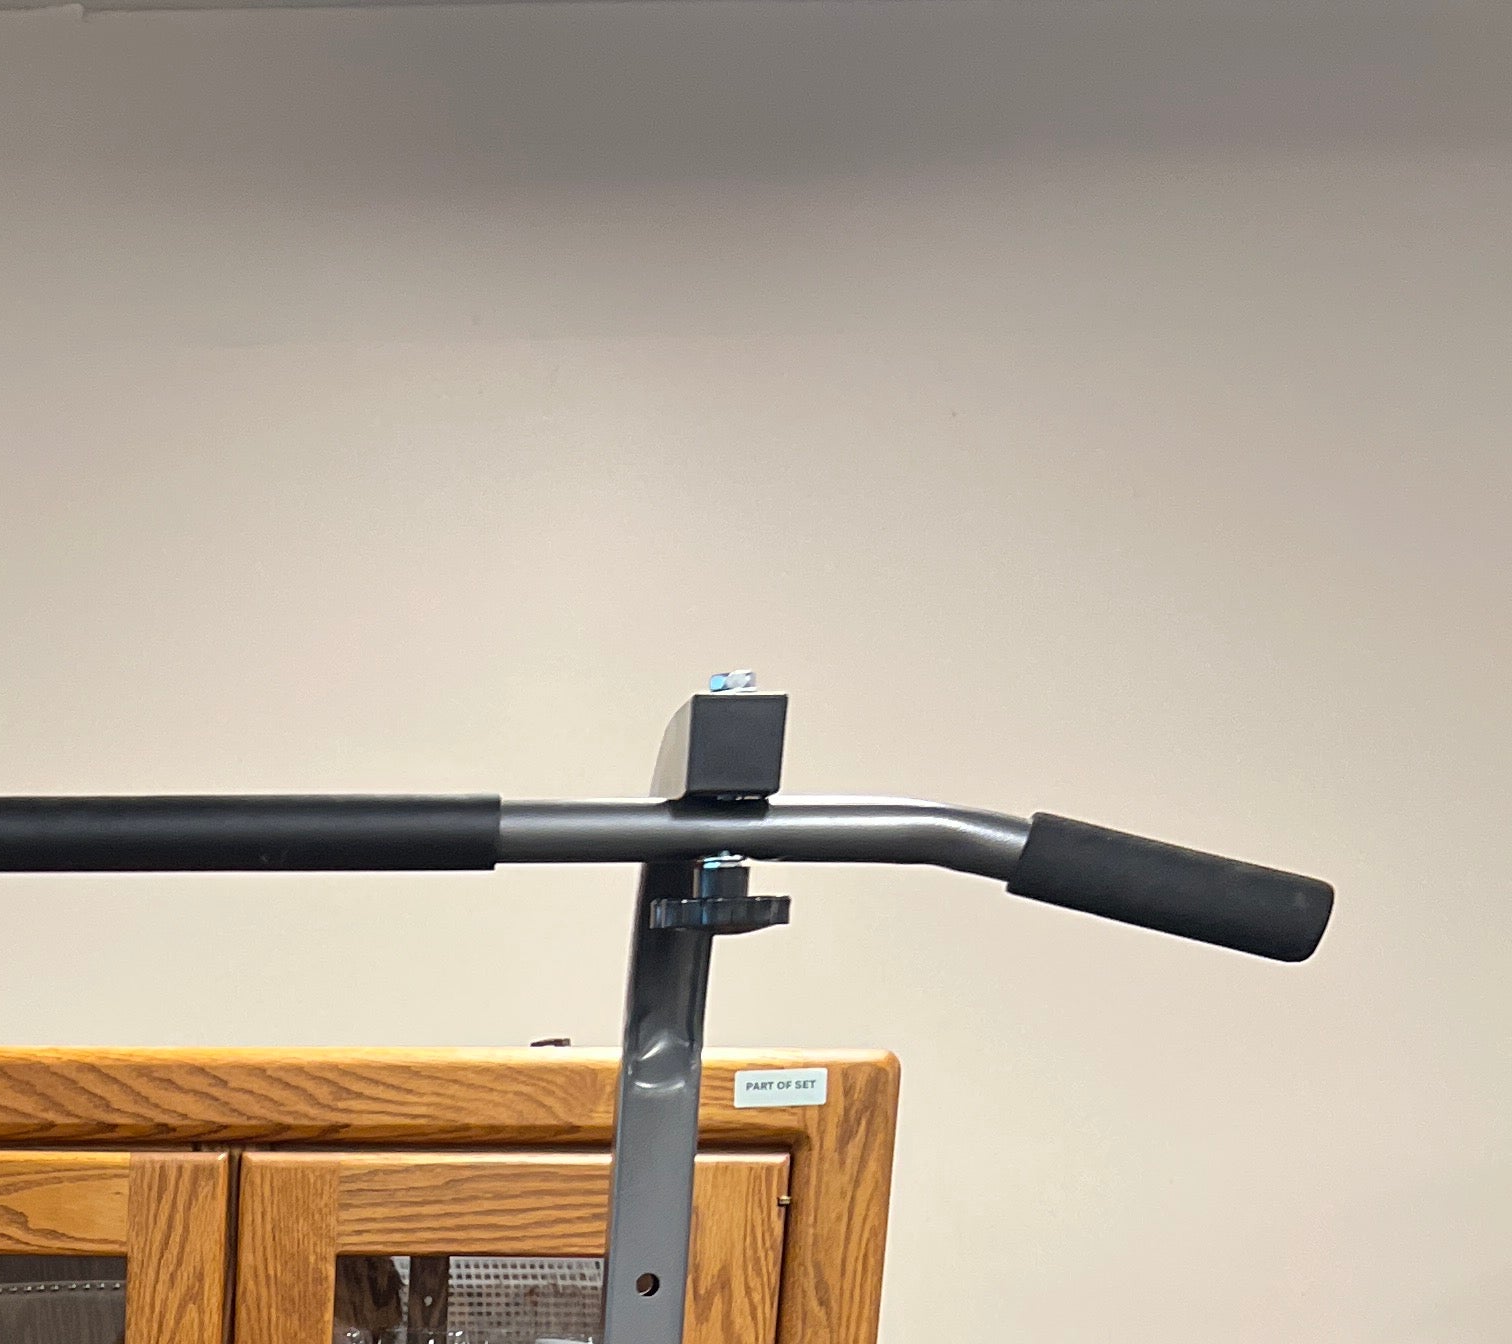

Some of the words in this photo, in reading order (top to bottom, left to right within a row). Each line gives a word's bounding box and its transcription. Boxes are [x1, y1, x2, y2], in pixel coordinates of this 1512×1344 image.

[745, 1081, 774, 1091] PART
[777, 1080, 792, 1090] OF
[795, 1079, 817, 1090] SET
